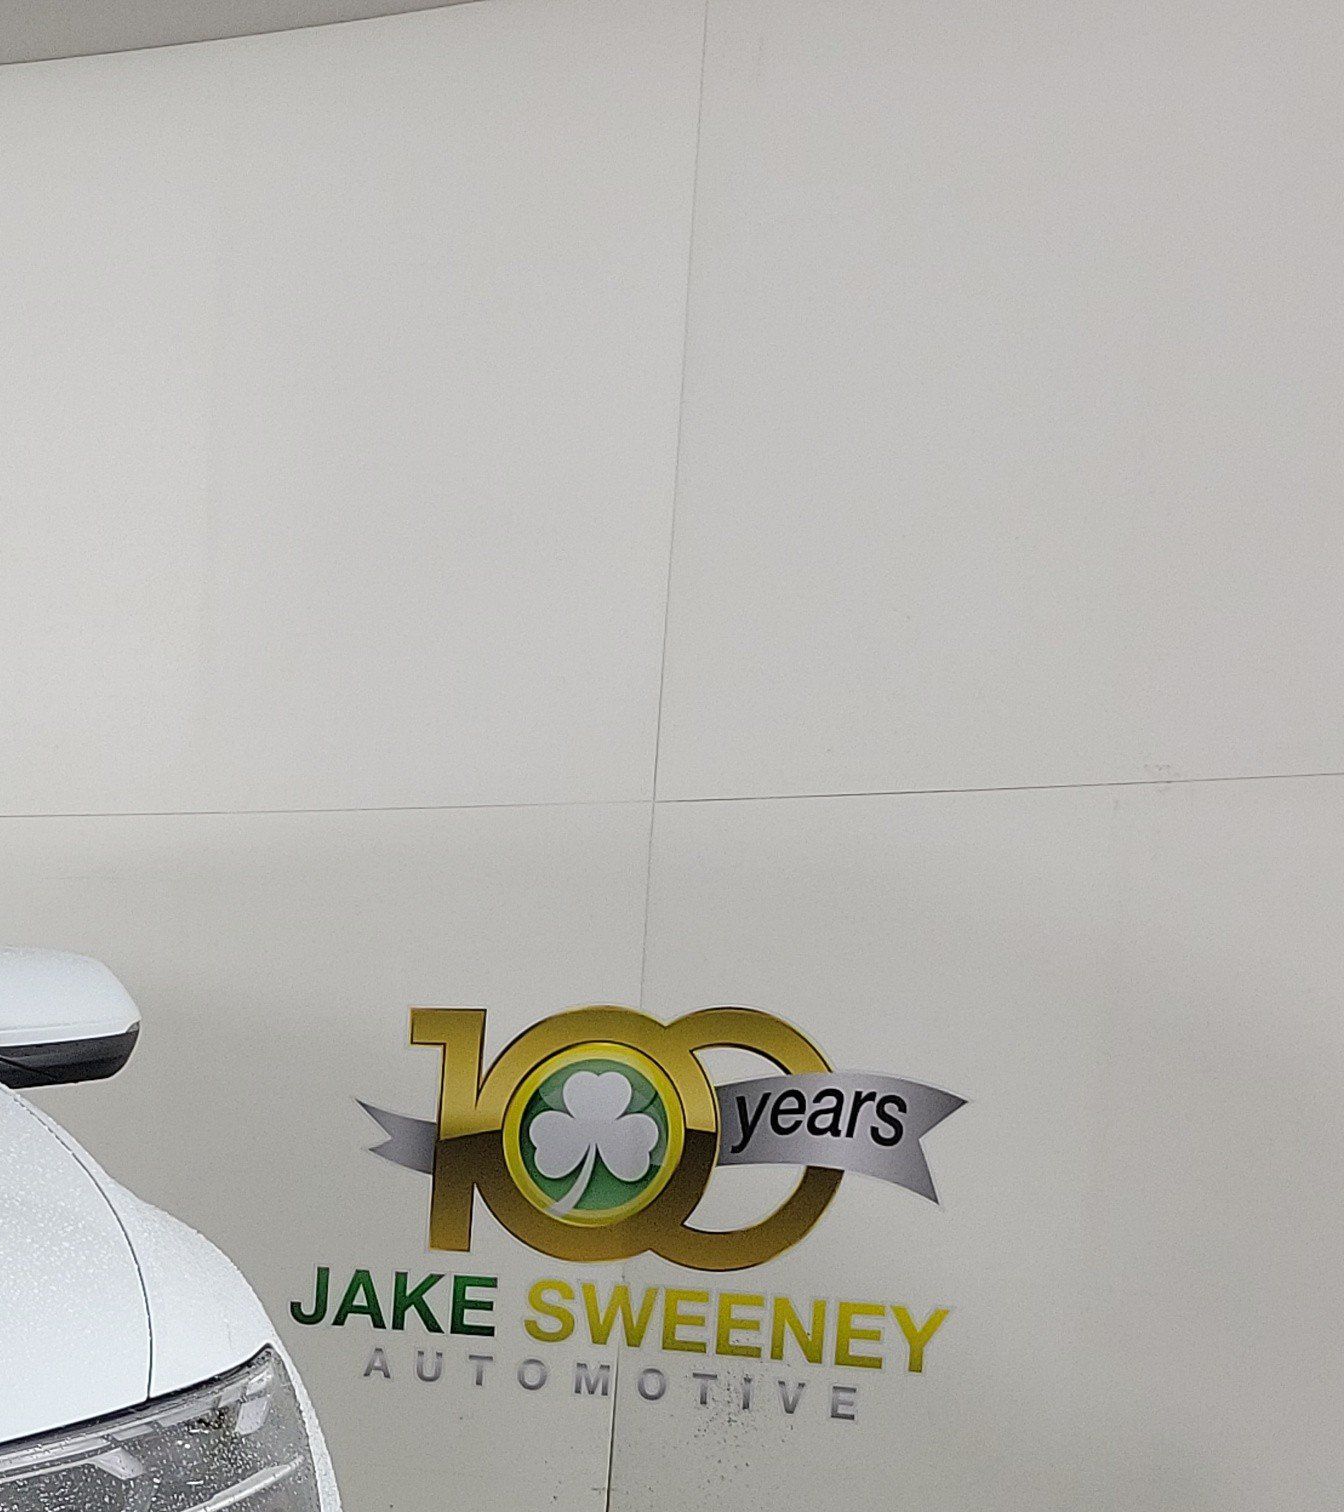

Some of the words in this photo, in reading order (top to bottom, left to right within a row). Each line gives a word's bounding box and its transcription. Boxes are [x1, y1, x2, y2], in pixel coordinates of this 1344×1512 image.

[410, 1006, 845, 1272] 100
[730, 1087, 908, 1154] years
[290, 1266, 498, 1337] JAKE
[524, 1279, 949, 1373] SWEENEY
[363, 1347, 859, 1420] AUTOMOTIVE
